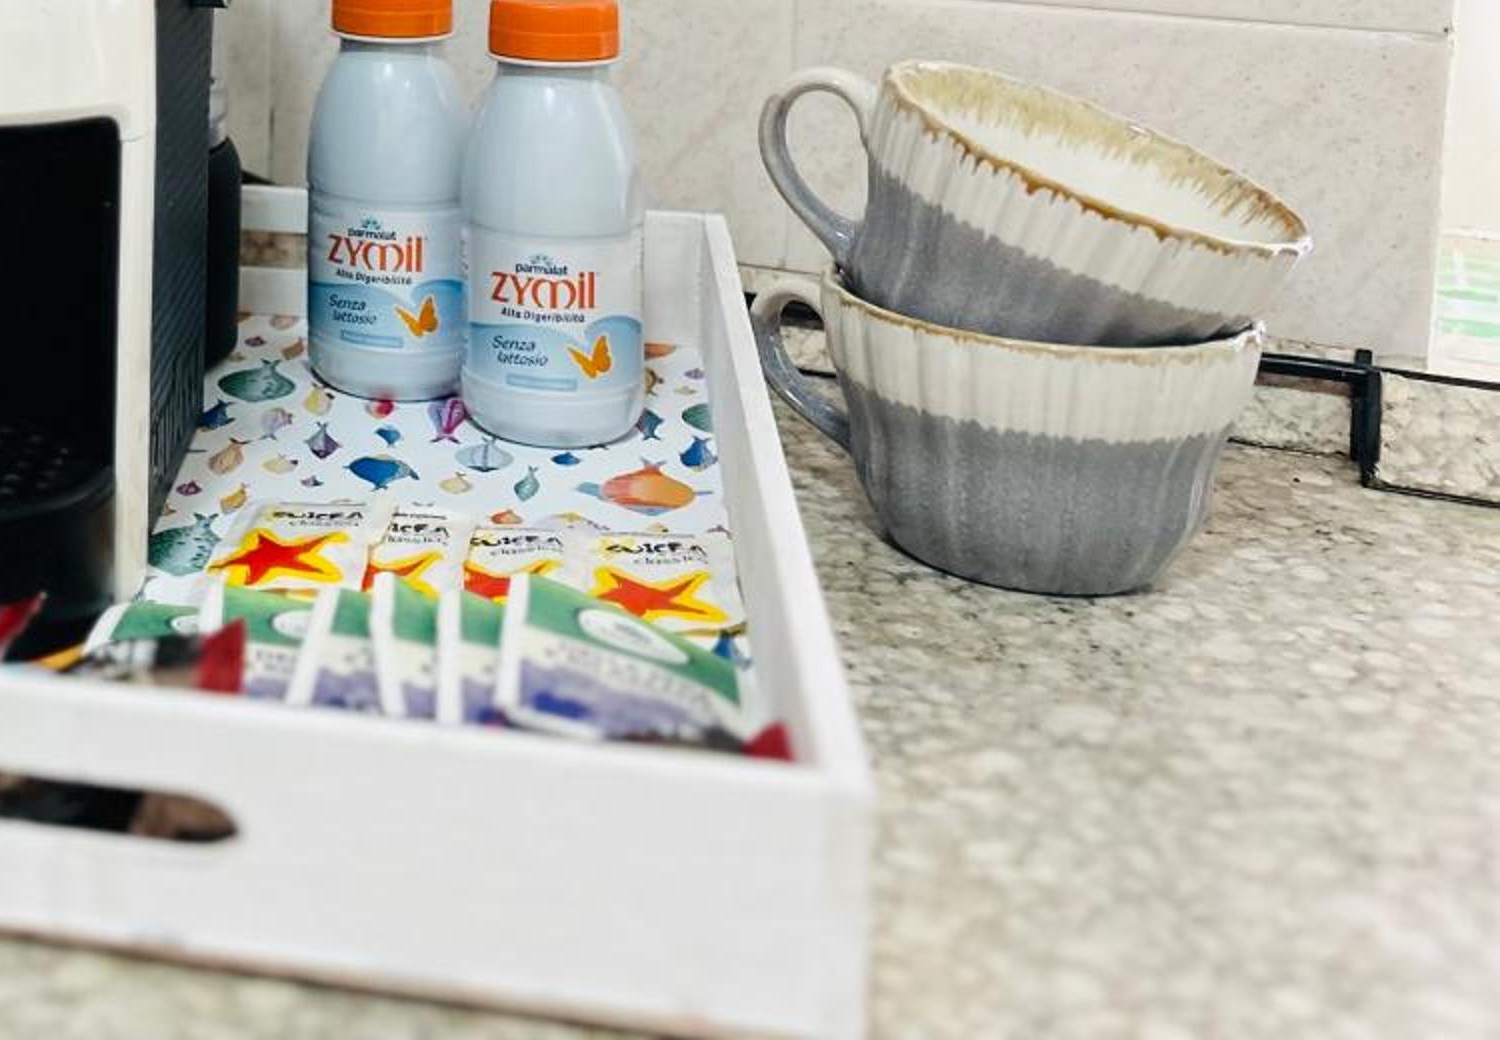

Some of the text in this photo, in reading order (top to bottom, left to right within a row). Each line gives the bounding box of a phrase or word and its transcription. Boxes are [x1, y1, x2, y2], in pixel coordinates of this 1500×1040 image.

[348, 227, 397, 241] parmalat
[515, 263, 568, 276] parmalat
[329, 294, 366, 311] Senza
[492, 335, 536, 352] Senza
